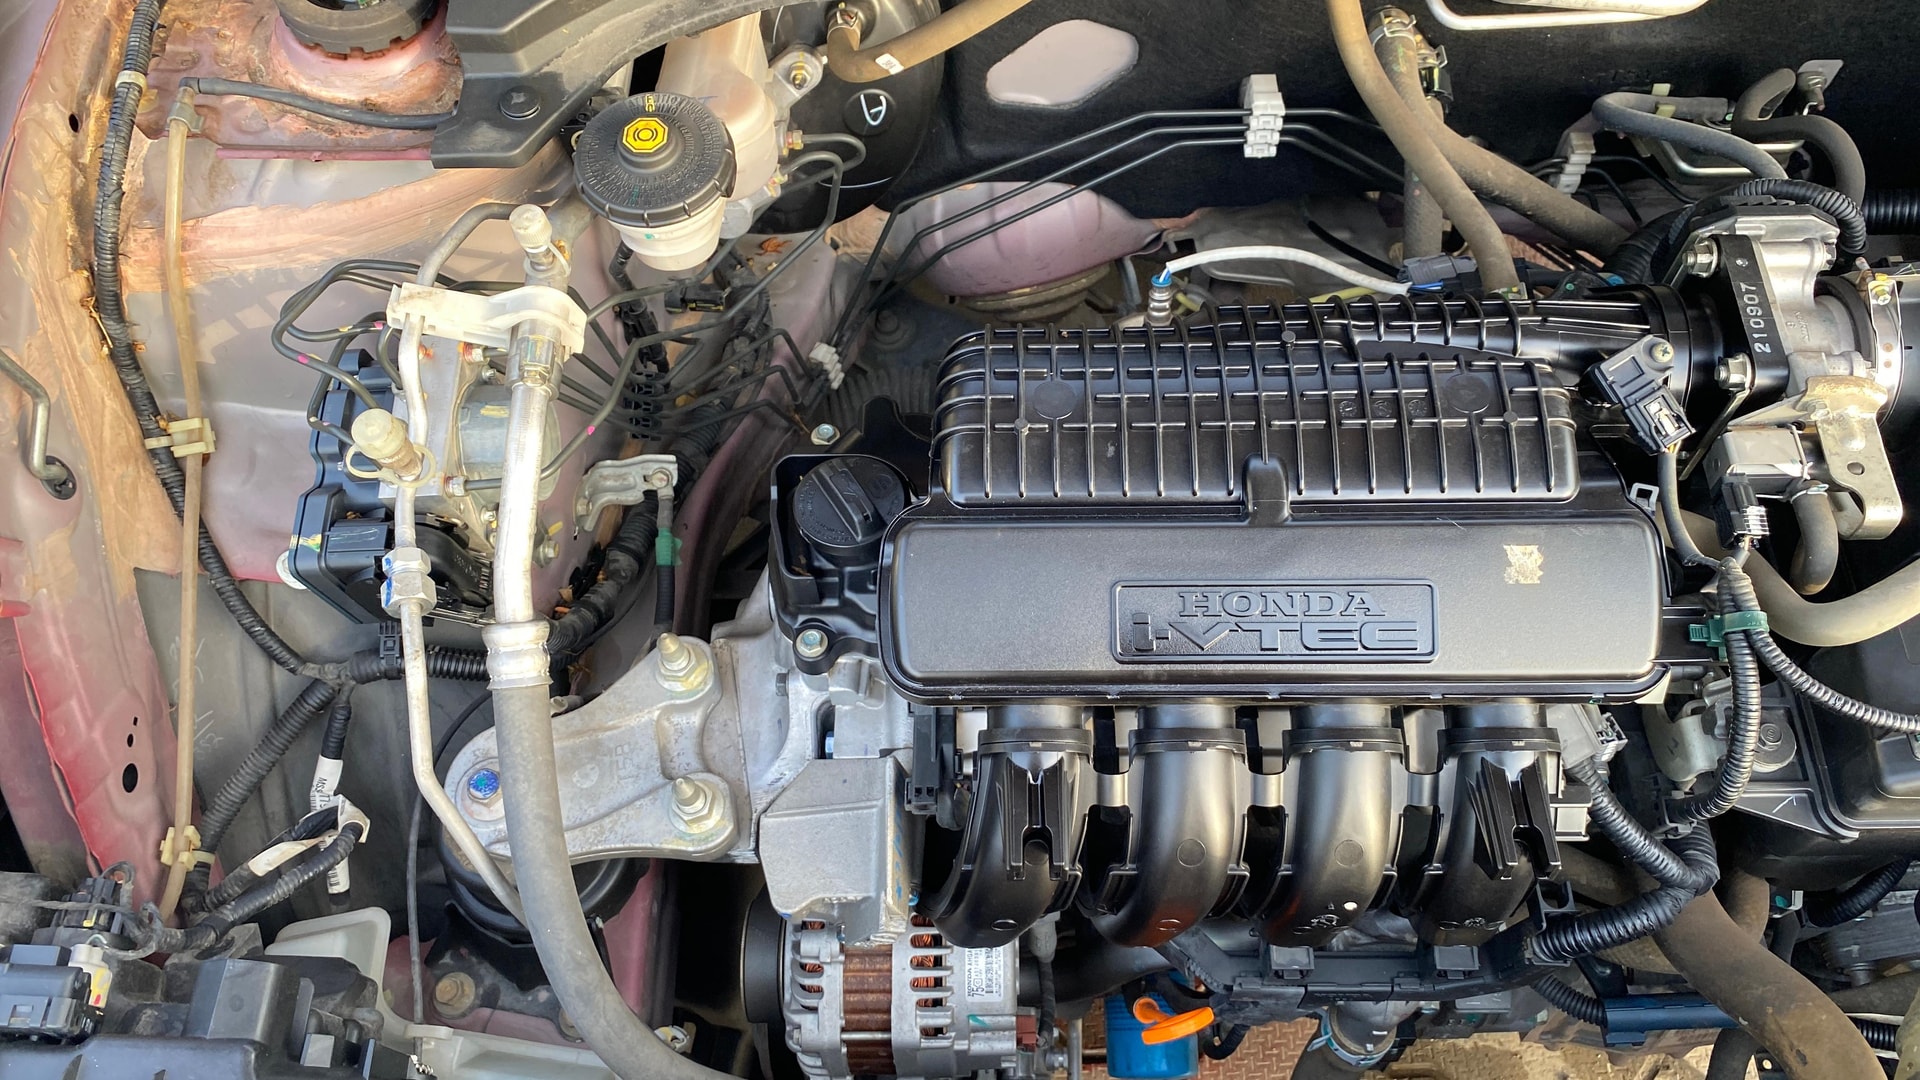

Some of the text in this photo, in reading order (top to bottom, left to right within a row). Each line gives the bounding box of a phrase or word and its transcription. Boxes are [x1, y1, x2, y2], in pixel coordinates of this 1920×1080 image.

[1740, 282, 1771, 352] 210907
[1178, 591, 1386, 617] HONDA
[1132, 612, 1420, 652] i-VTEC
